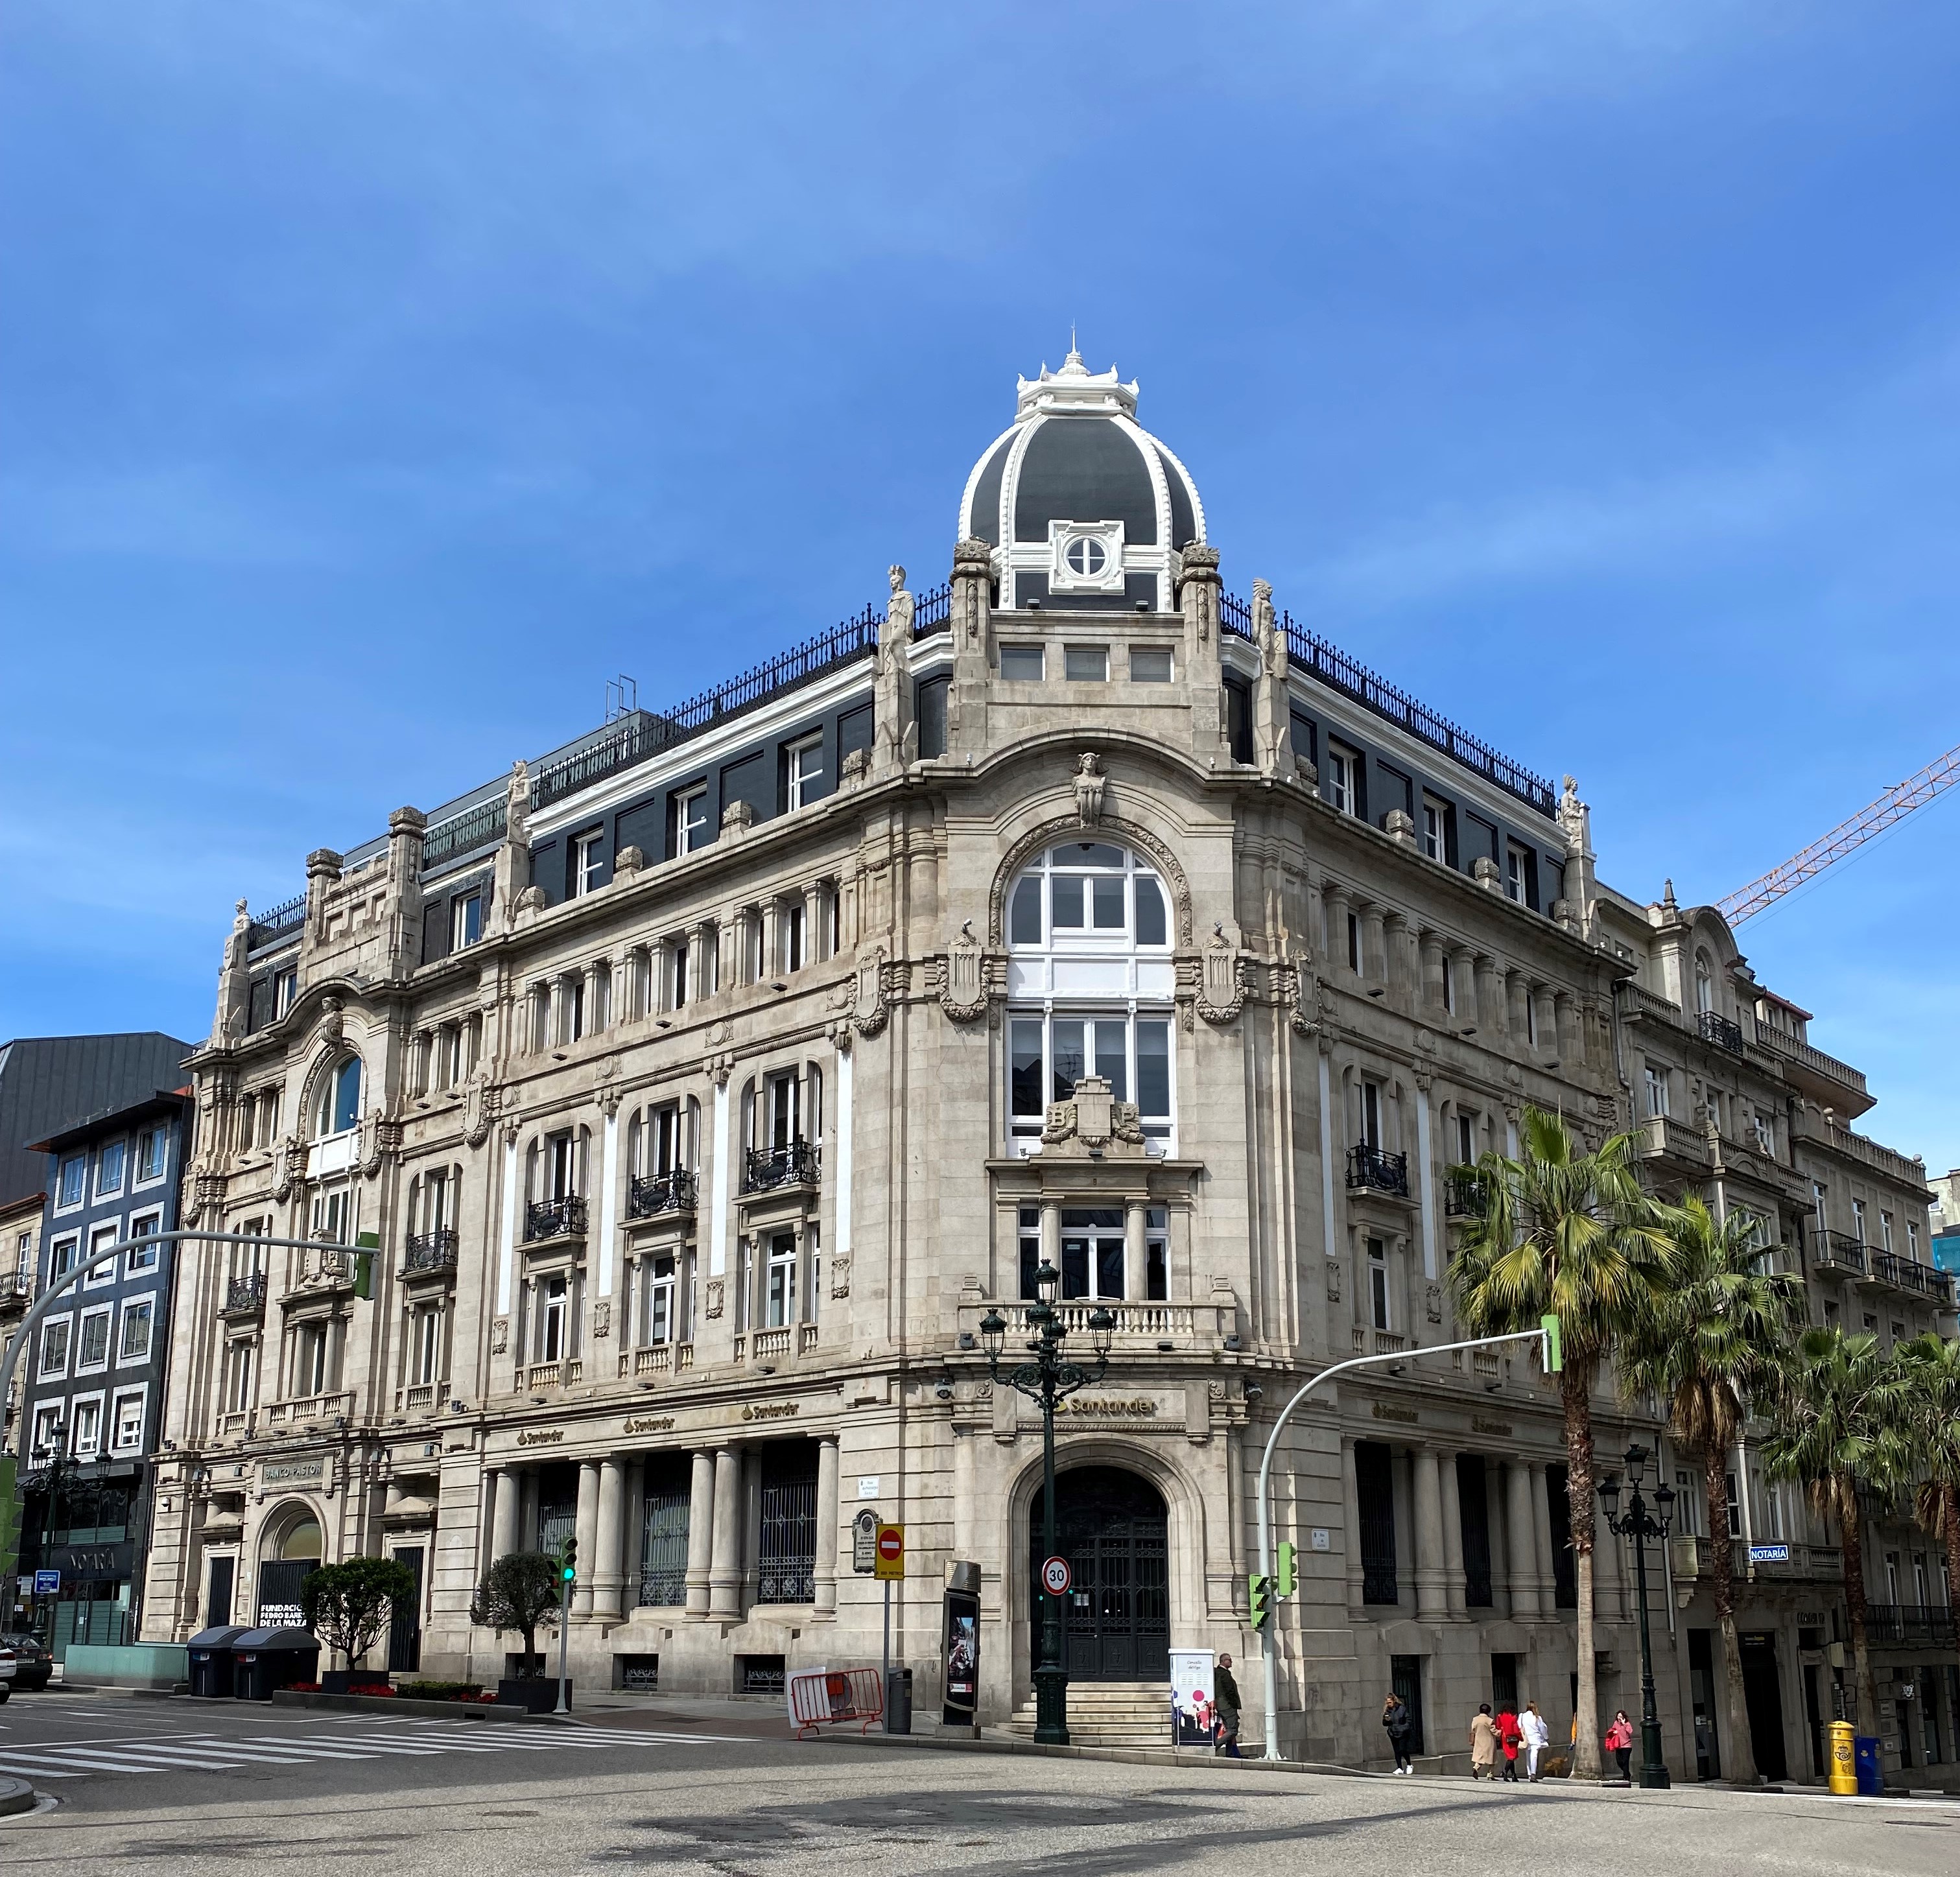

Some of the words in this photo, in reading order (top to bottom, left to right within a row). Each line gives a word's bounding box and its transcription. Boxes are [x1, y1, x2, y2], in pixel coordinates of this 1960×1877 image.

[1051, 1109, 1065, 1126] B
[1120, 1109, 1135, 1126] P
[753, 1402, 799, 1419] Santander
[1070, 1397, 1155, 1411] Santander
[634, 1417, 675, 1432] Santander
[527, 1430, 563, 1445] Santander
[266, 1468, 290, 1479] BANCO
[293, 1465, 322, 1476] PASTOR
[1751, 1548, 1786, 1559] NOTARÍA
[1049, 1570, 1065, 1581] 30
